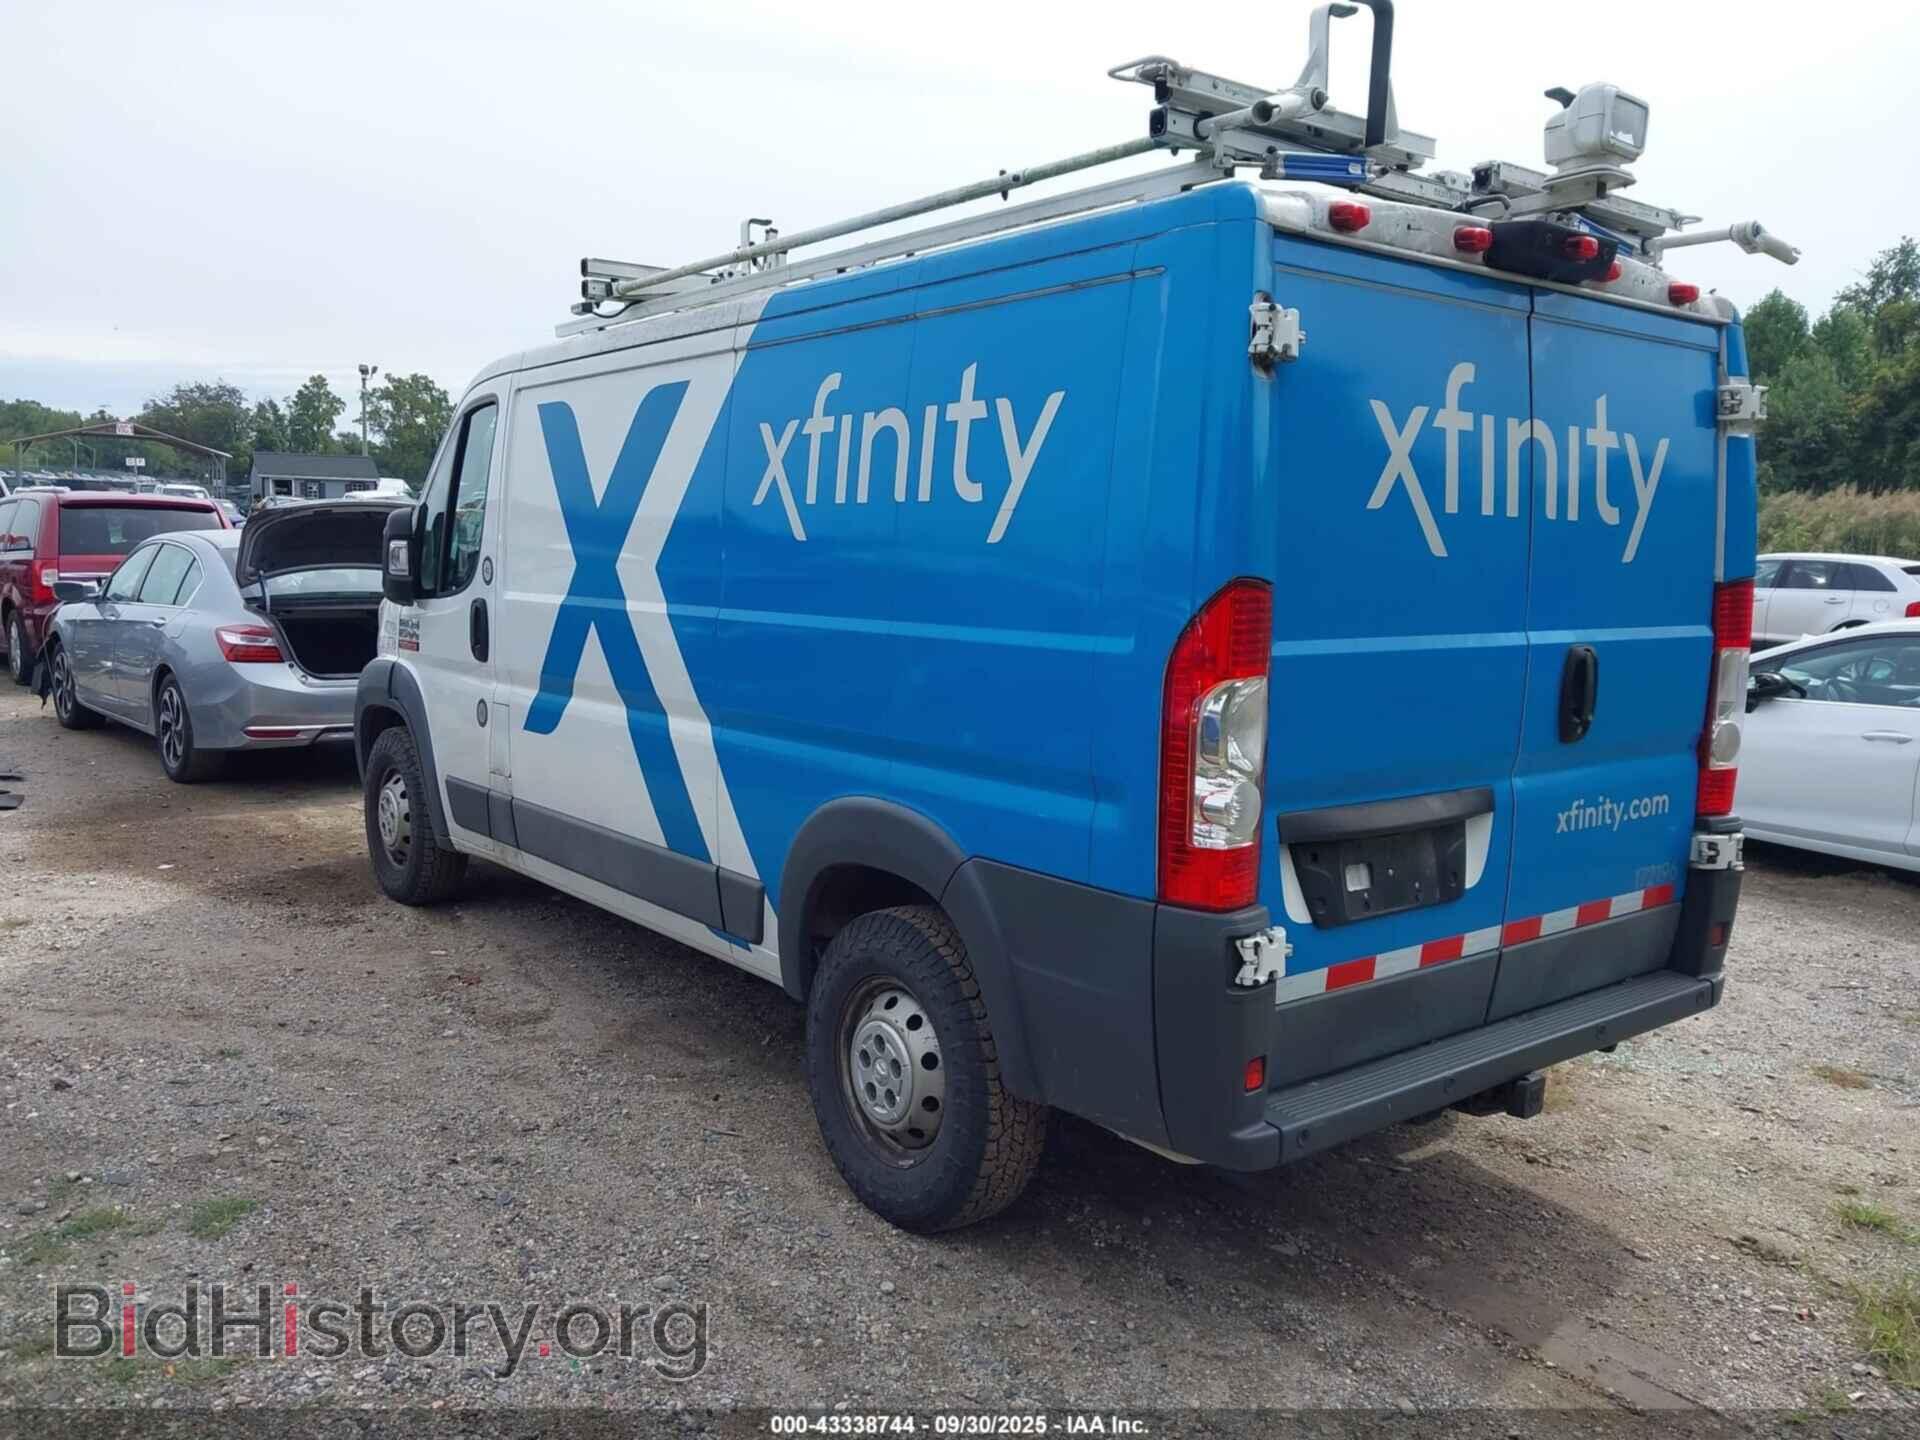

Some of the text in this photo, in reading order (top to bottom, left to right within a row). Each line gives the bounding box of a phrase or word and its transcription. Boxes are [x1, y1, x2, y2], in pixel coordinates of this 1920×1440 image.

[752, 361, 1065, 543] xfinity
[1366, 362, 1670, 563] xfinity
[1556, 793, 1670, 834] xfinity.com
